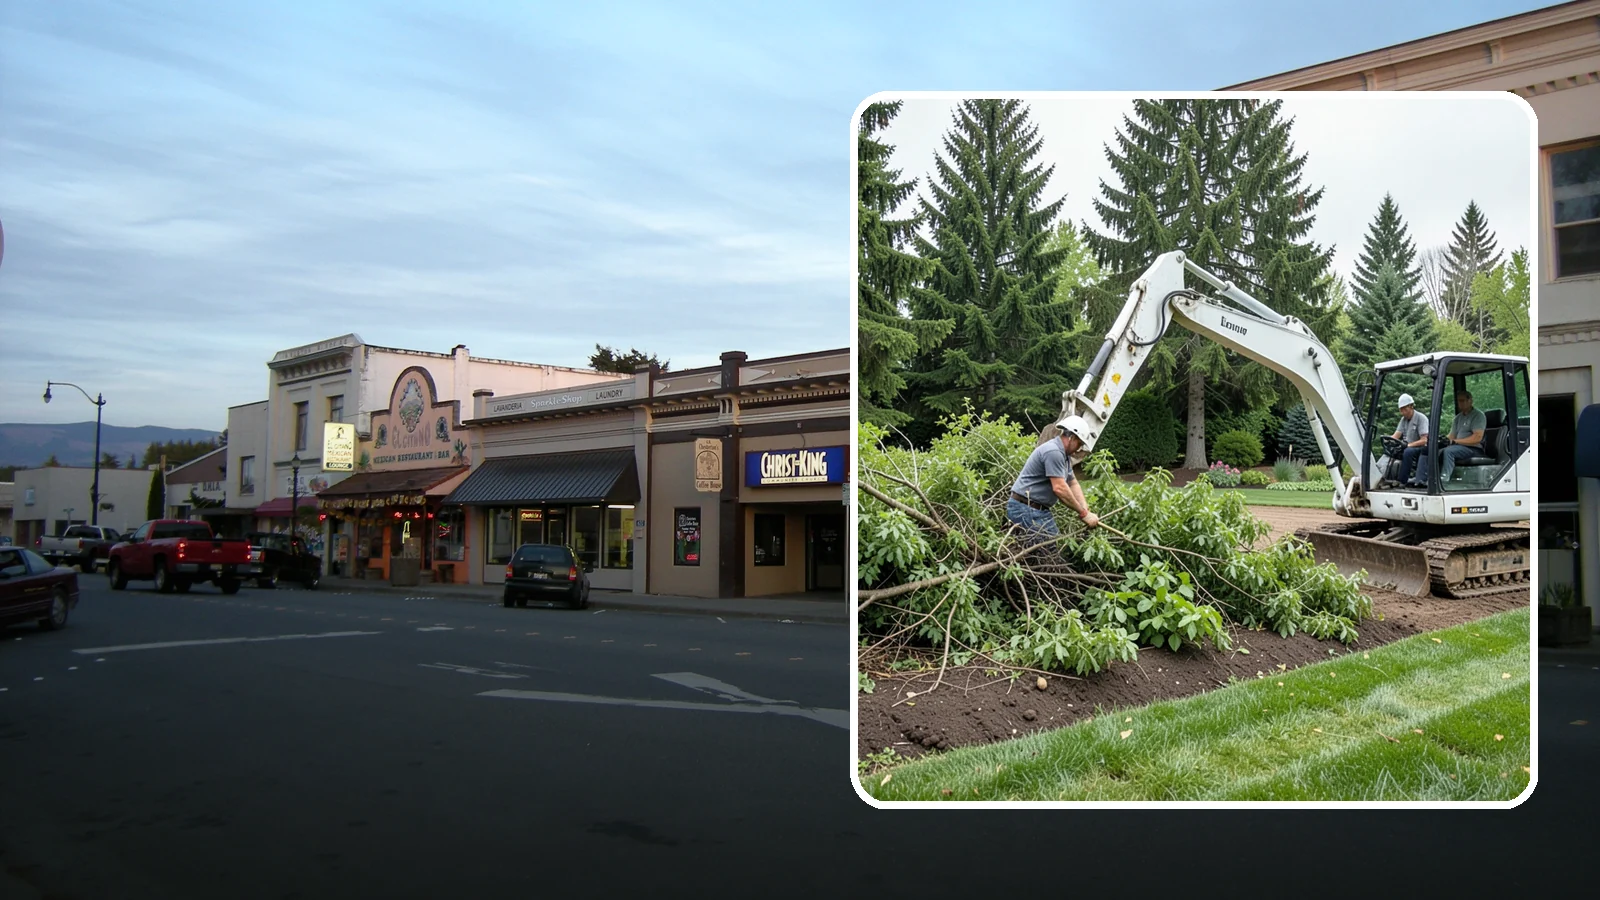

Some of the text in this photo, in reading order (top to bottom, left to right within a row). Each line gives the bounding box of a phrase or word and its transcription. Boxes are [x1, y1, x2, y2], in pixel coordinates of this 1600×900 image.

[562, 394, 582, 405] Shop
[595, 388, 623, 400] LAUNDRY
[493, 402, 522, 413] LAVANDERIA
[327, 450, 352, 458] MEXICAN
[373, 454, 396, 464] MEXICAN
[397, 451, 433, 462] RESTAURANT
[438, 450, 450, 459] BAR
[761, 452, 797, 478] CHRIST
[799, 450, 827, 477] KING
